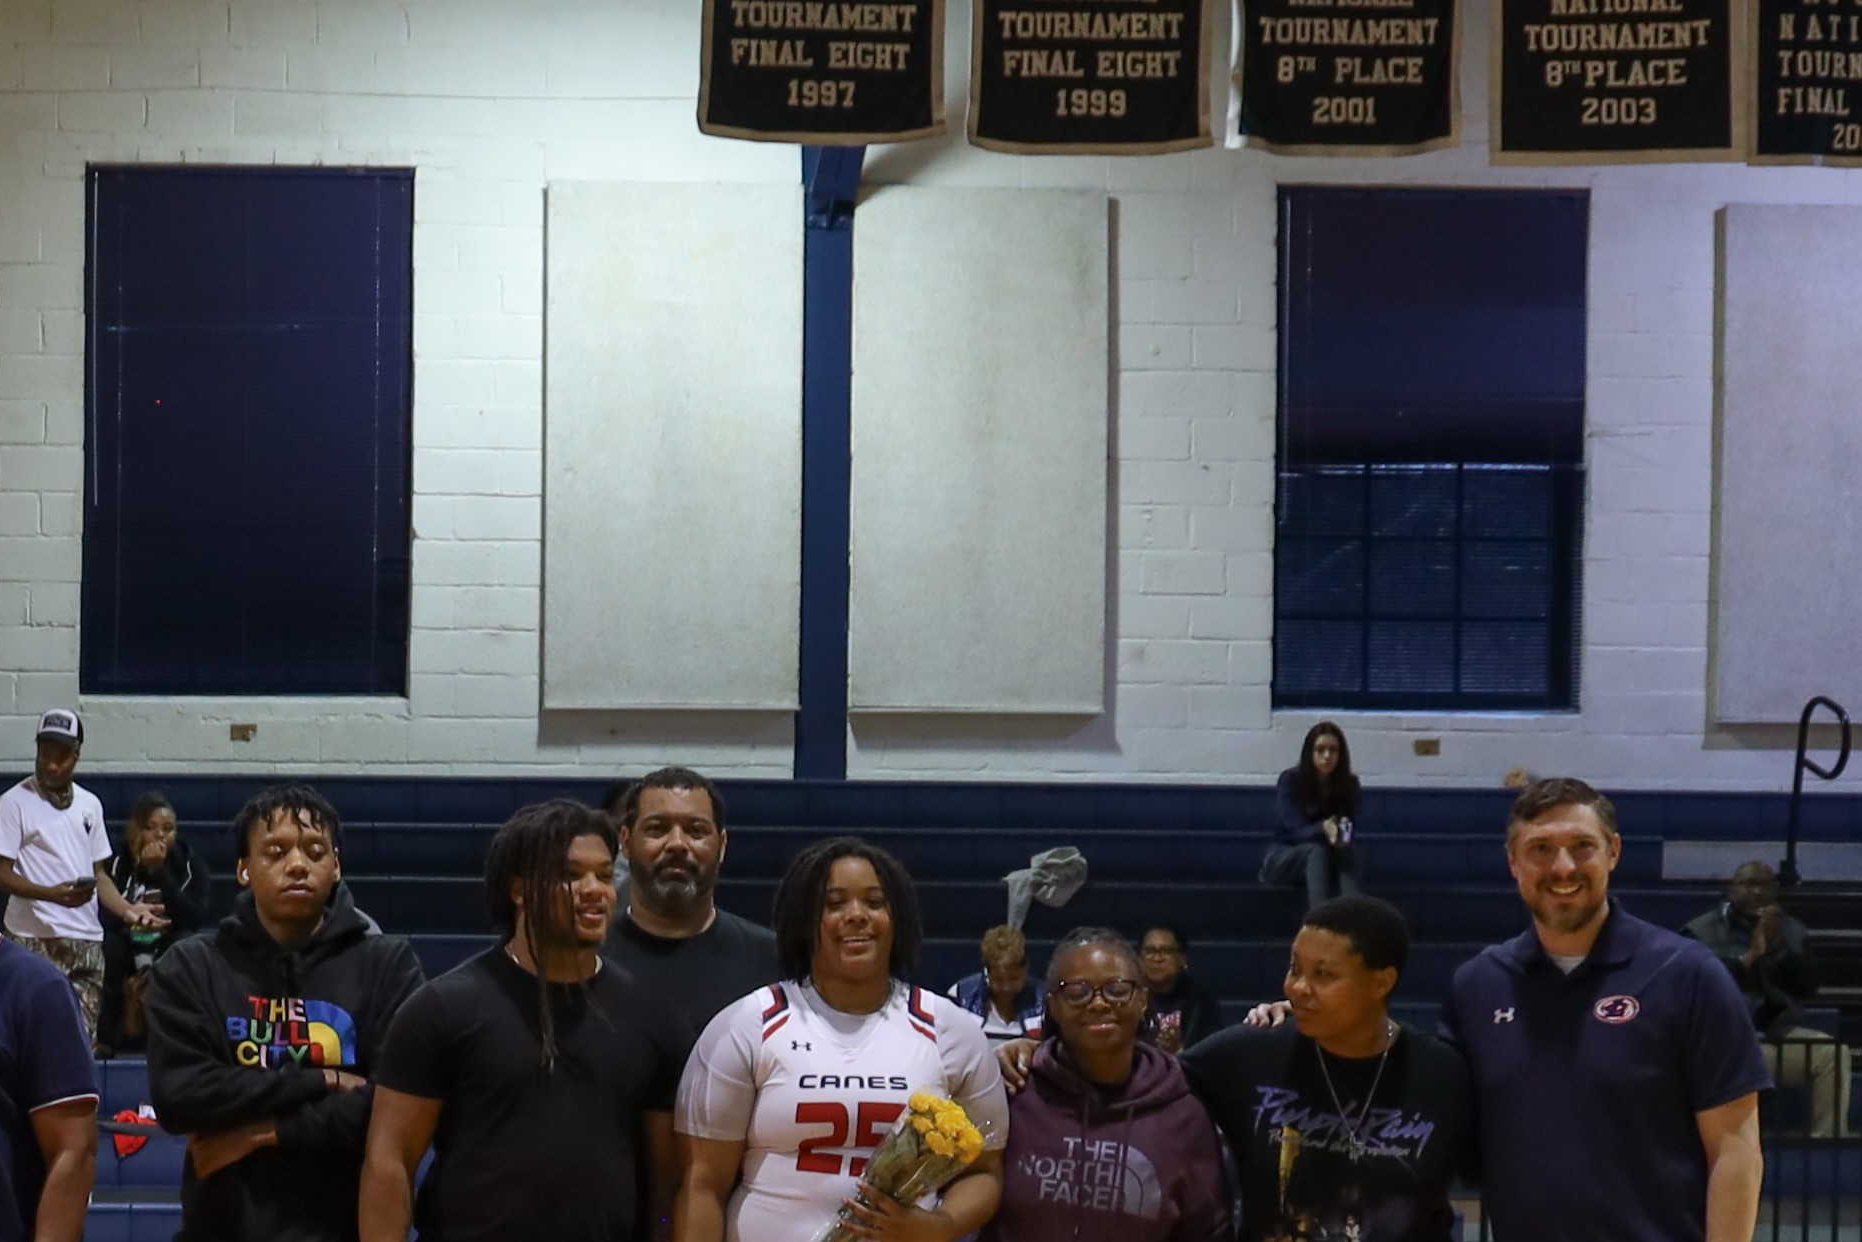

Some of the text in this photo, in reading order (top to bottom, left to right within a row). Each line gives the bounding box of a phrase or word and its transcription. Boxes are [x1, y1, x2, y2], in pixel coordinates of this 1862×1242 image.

[731, 1, 917, 32] TOURNAMENT
[998, 11, 1184, 40] TOURNAMENT
[1259, 16, 1438, 45] TOURNAMENT
[1524, 19, 1711, 50] TOURNAMENT
[731, 38, 910, 70] FINAL EIGHT
[1003, 50, 1182, 78] FINAL EIGHT
[1277, 55, 1424, 84] 8TH PLACE
[1545, 58, 1687, 88] 8TH PLACE
[787, 78, 856, 108] 1997
[1056, 88, 1127, 117] 1999
[1777, 87, 1850, 116] FINAL
[1312, 96, 1376, 125] 2001
[1581, 98, 1657, 125] 2003
[249, 996, 306, 1022] THE
[226, 1016, 310, 1046] BULL
[237, 1040, 308, 1069] CITY
[799, 1074, 909, 1090] CANES
[795, 1102, 908, 1178] 25
[1063, 1136, 1118, 1163] THE
